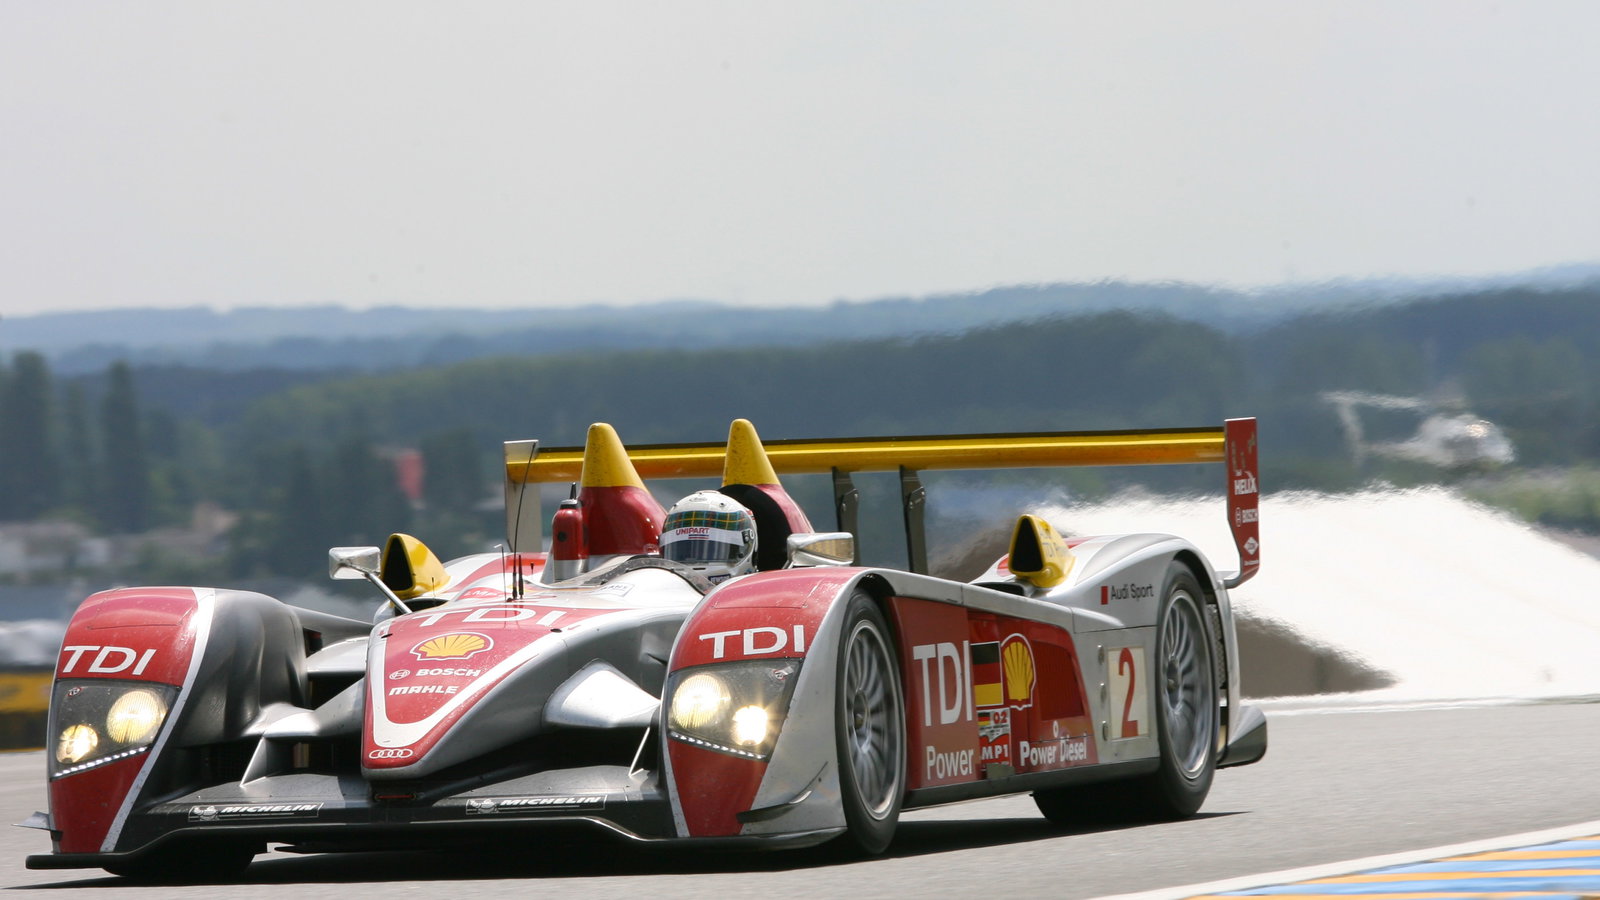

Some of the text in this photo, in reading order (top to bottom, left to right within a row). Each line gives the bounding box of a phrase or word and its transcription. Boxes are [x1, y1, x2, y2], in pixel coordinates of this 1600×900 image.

[1234, 477, 1257, 495] HELIX
[675, 527, 710, 536] UNIPART
[1110, 583, 1154, 602] Audi Sport
[412, 607, 567, 627] TDI
[699, 625, 805, 659] TDI
[62, 645, 157, 676] TDI
[416, 668, 481, 677] BOSCH
[389, 685, 461, 696] MAHLE
[913, 640, 973, 727] TDI
[1119, 647, 1139, 738] 2
[1019, 732, 1087, 767] Power Diesel
[926, 745, 974, 780] Power
[220, 804, 318, 813] MICHELIN
[501, 796, 602, 806] MICHELIN
